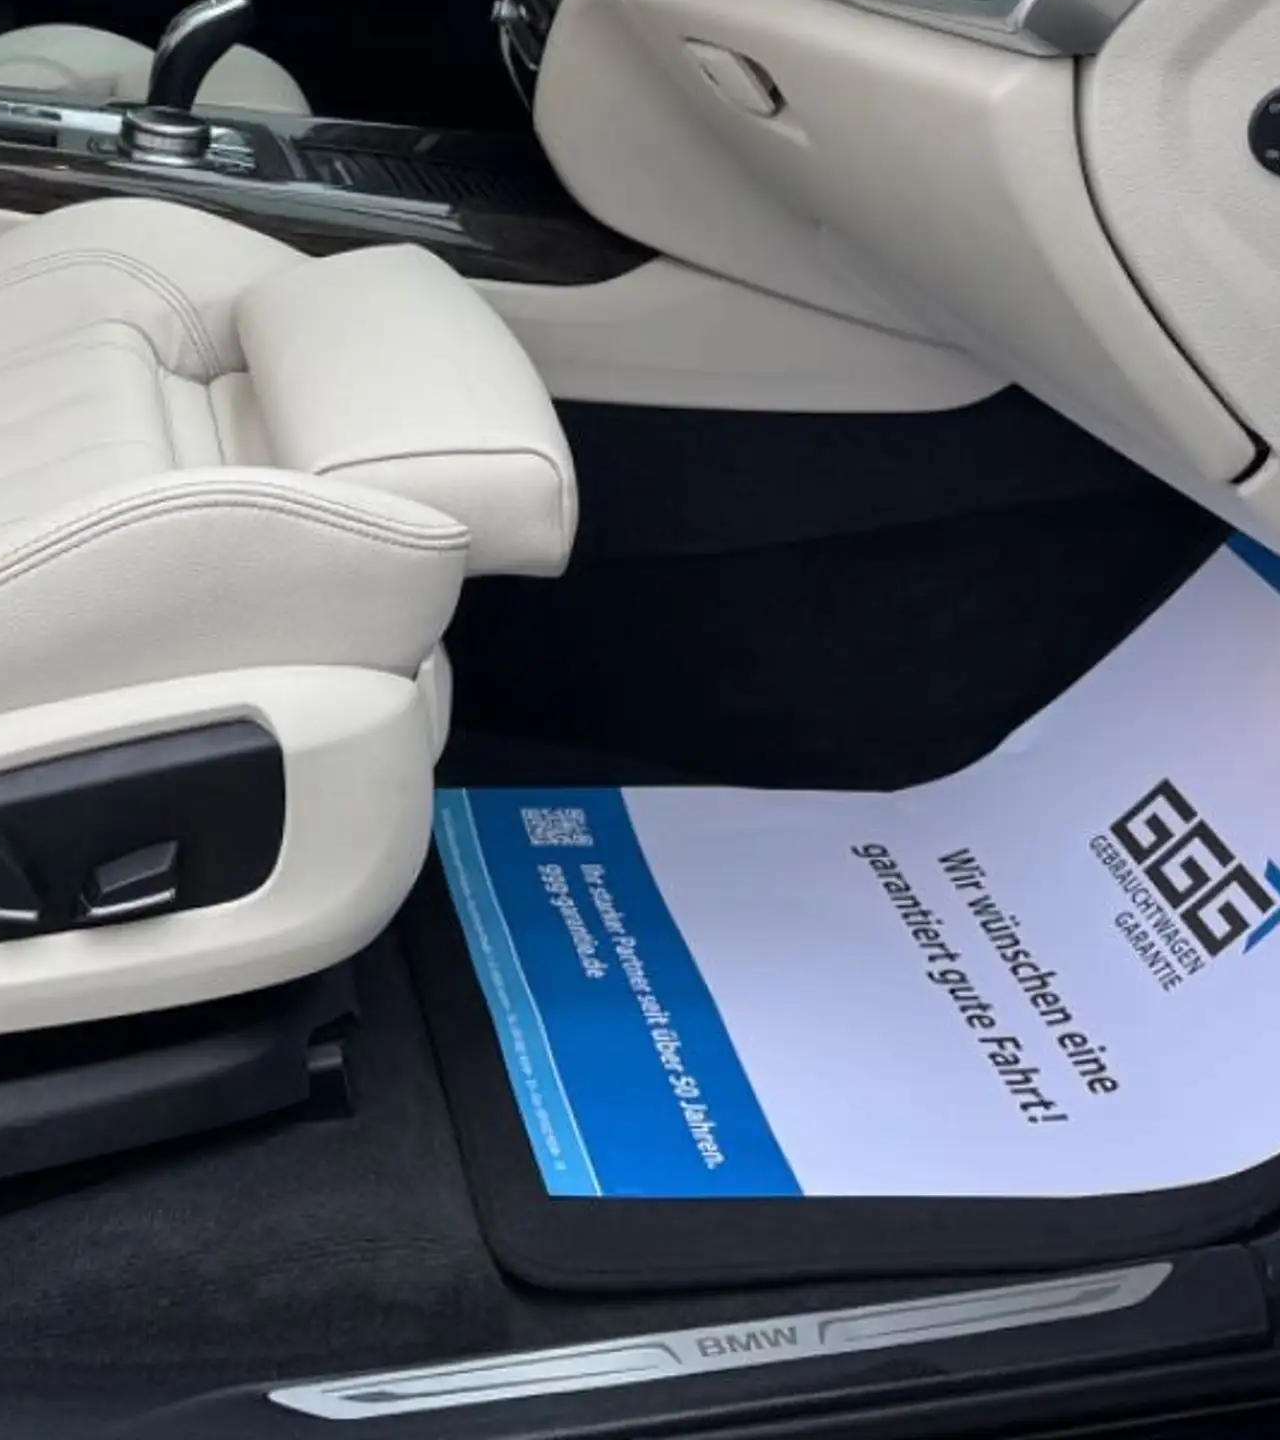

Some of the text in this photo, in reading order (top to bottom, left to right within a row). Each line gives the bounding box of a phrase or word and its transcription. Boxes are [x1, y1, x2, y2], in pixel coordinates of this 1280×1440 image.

[1109, 777, 1276, 958] GGG
[1088, 835, 1206, 975] GEBRAUCHTWAGEN
[611, 936, 652, 993] Partner
[850, 842, 1069, 1124] garantiert gute Fahrt!
[937, 848, 1120, 1095] Wir wünschen eine
[1114, 911, 1184, 992] GARANTIE
[637, 993, 671, 1027] seit
[650, 1028, 684, 1073] über
[668, 1074, 701, 1099] 50
[679, 1100, 726, 1170] Jahren.
[697, 1326, 797, 1358] BMW
